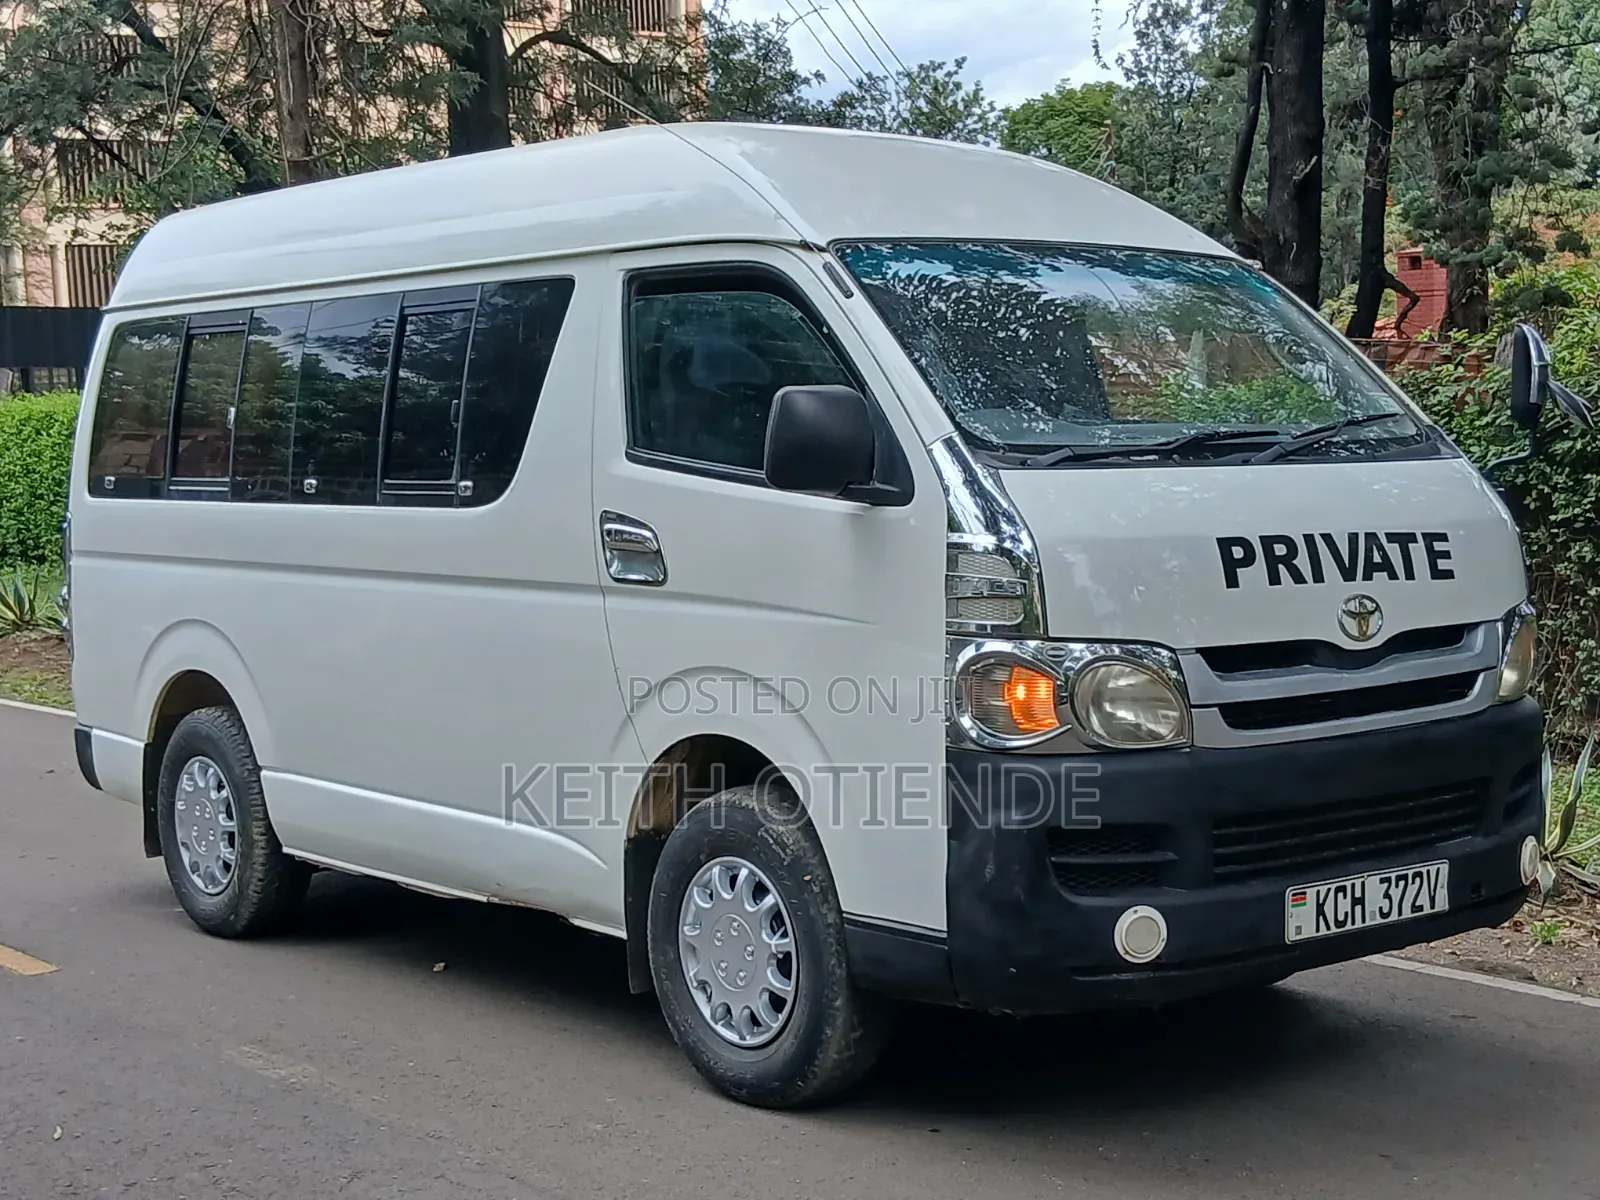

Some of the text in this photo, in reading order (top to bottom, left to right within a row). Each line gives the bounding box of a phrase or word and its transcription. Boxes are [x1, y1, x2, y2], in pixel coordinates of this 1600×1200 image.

[1215, 531, 1456, 589] PRIVATE
[1315, 867, 1441, 933] KCH 372V
